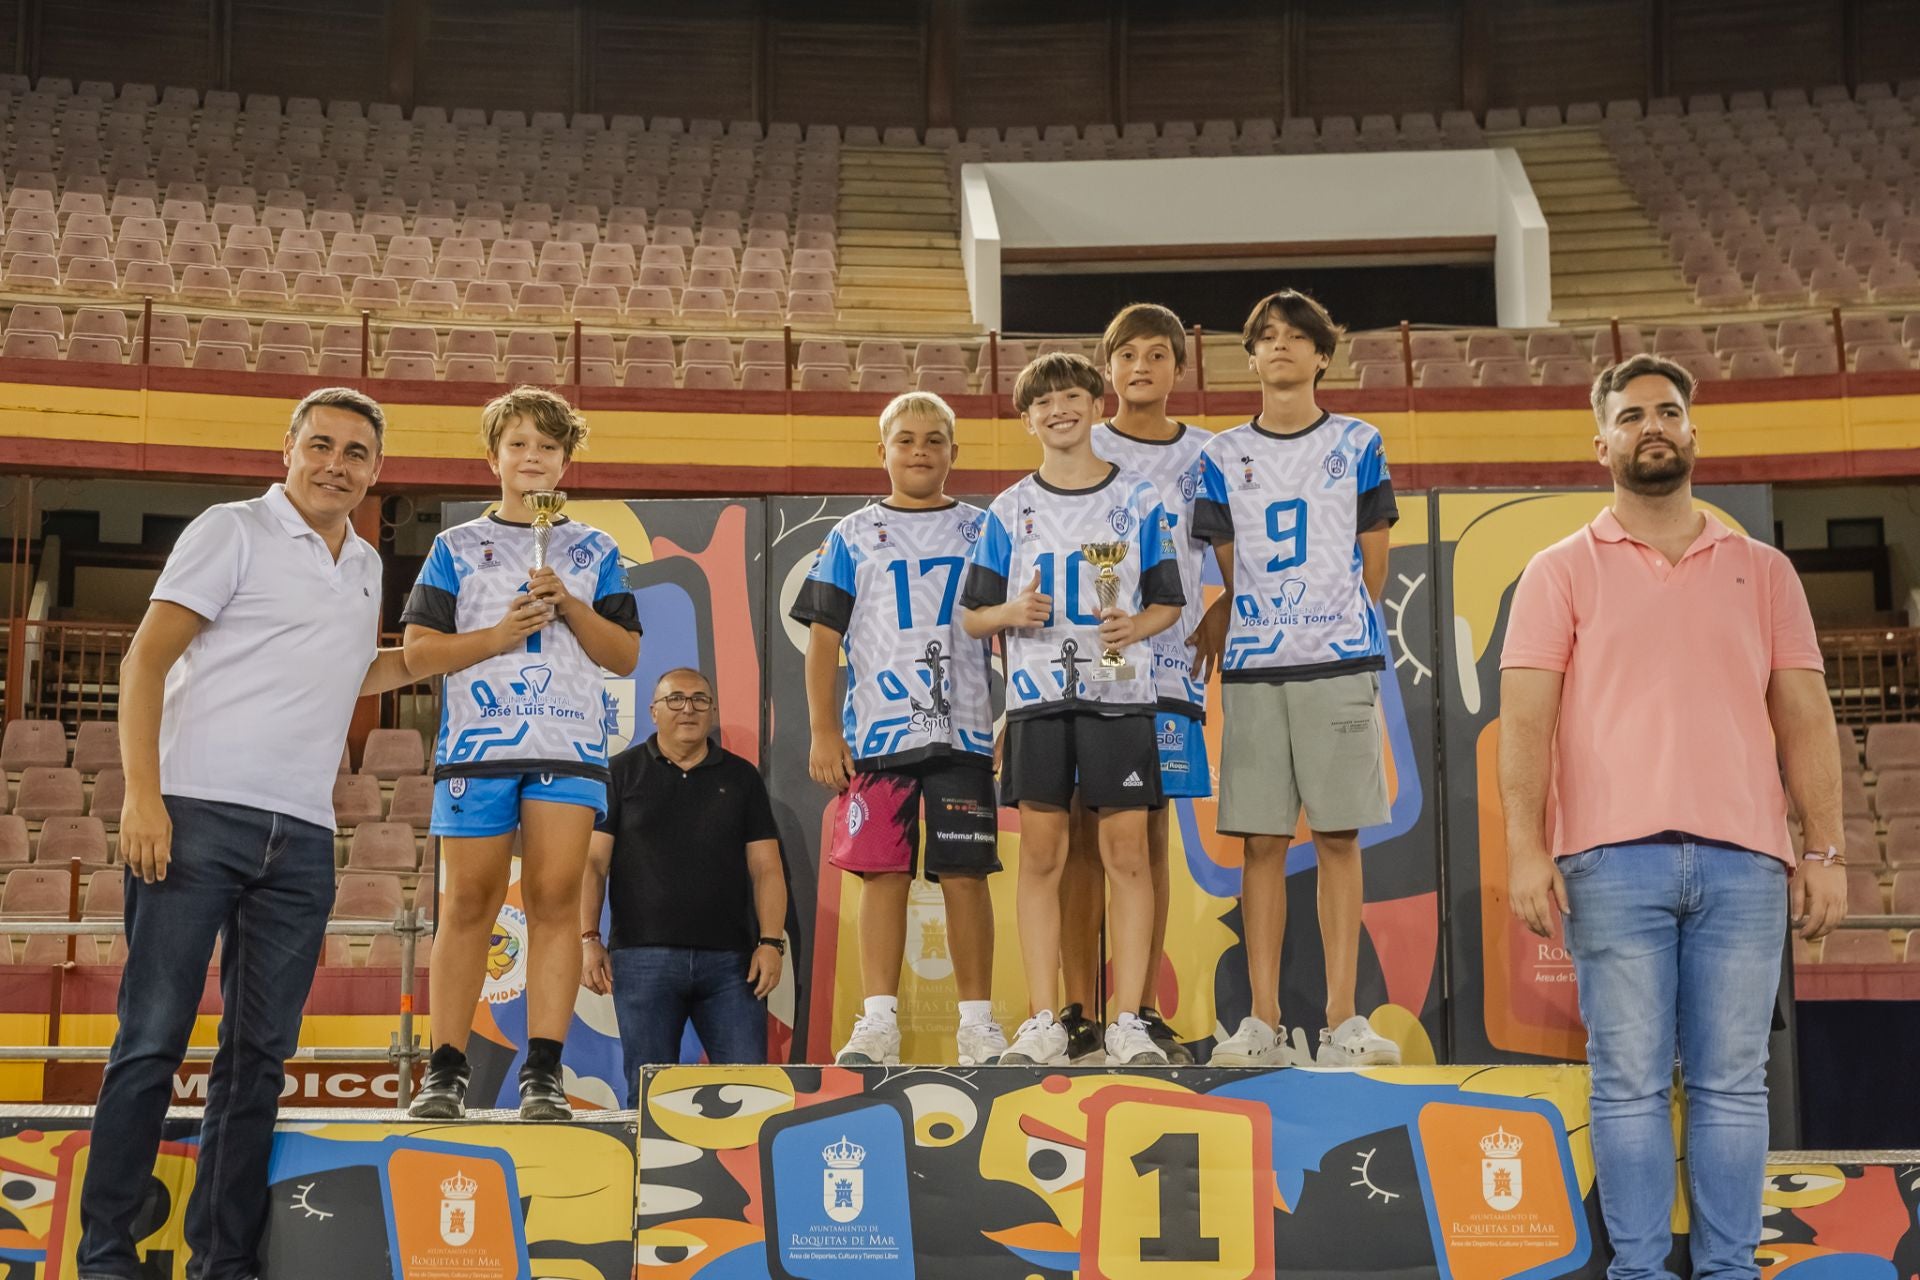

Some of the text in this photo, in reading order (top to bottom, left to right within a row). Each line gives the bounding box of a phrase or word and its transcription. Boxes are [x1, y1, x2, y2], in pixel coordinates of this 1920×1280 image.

[1264, 498, 1308, 573] 9
[886, 556, 965, 630] 17
[1033, 550, 1101, 628] 10
[1242, 616, 1270, 627] José
[1273, 614, 1299, 626] Luis
[480, 703, 585, 720] José Luis Torres
[907, 711, 952, 738] Espig
[936, 831, 973, 841] Verdemar
[1556, 972, 1568, 982] de
[489, 987, 518, 1001] VIDA
[1130, 1133, 1220, 1262] 1
[792, 1234, 895, 1247] ROQUETAS DE MAR
[863, 1252, 883, 1260] Tiempo
